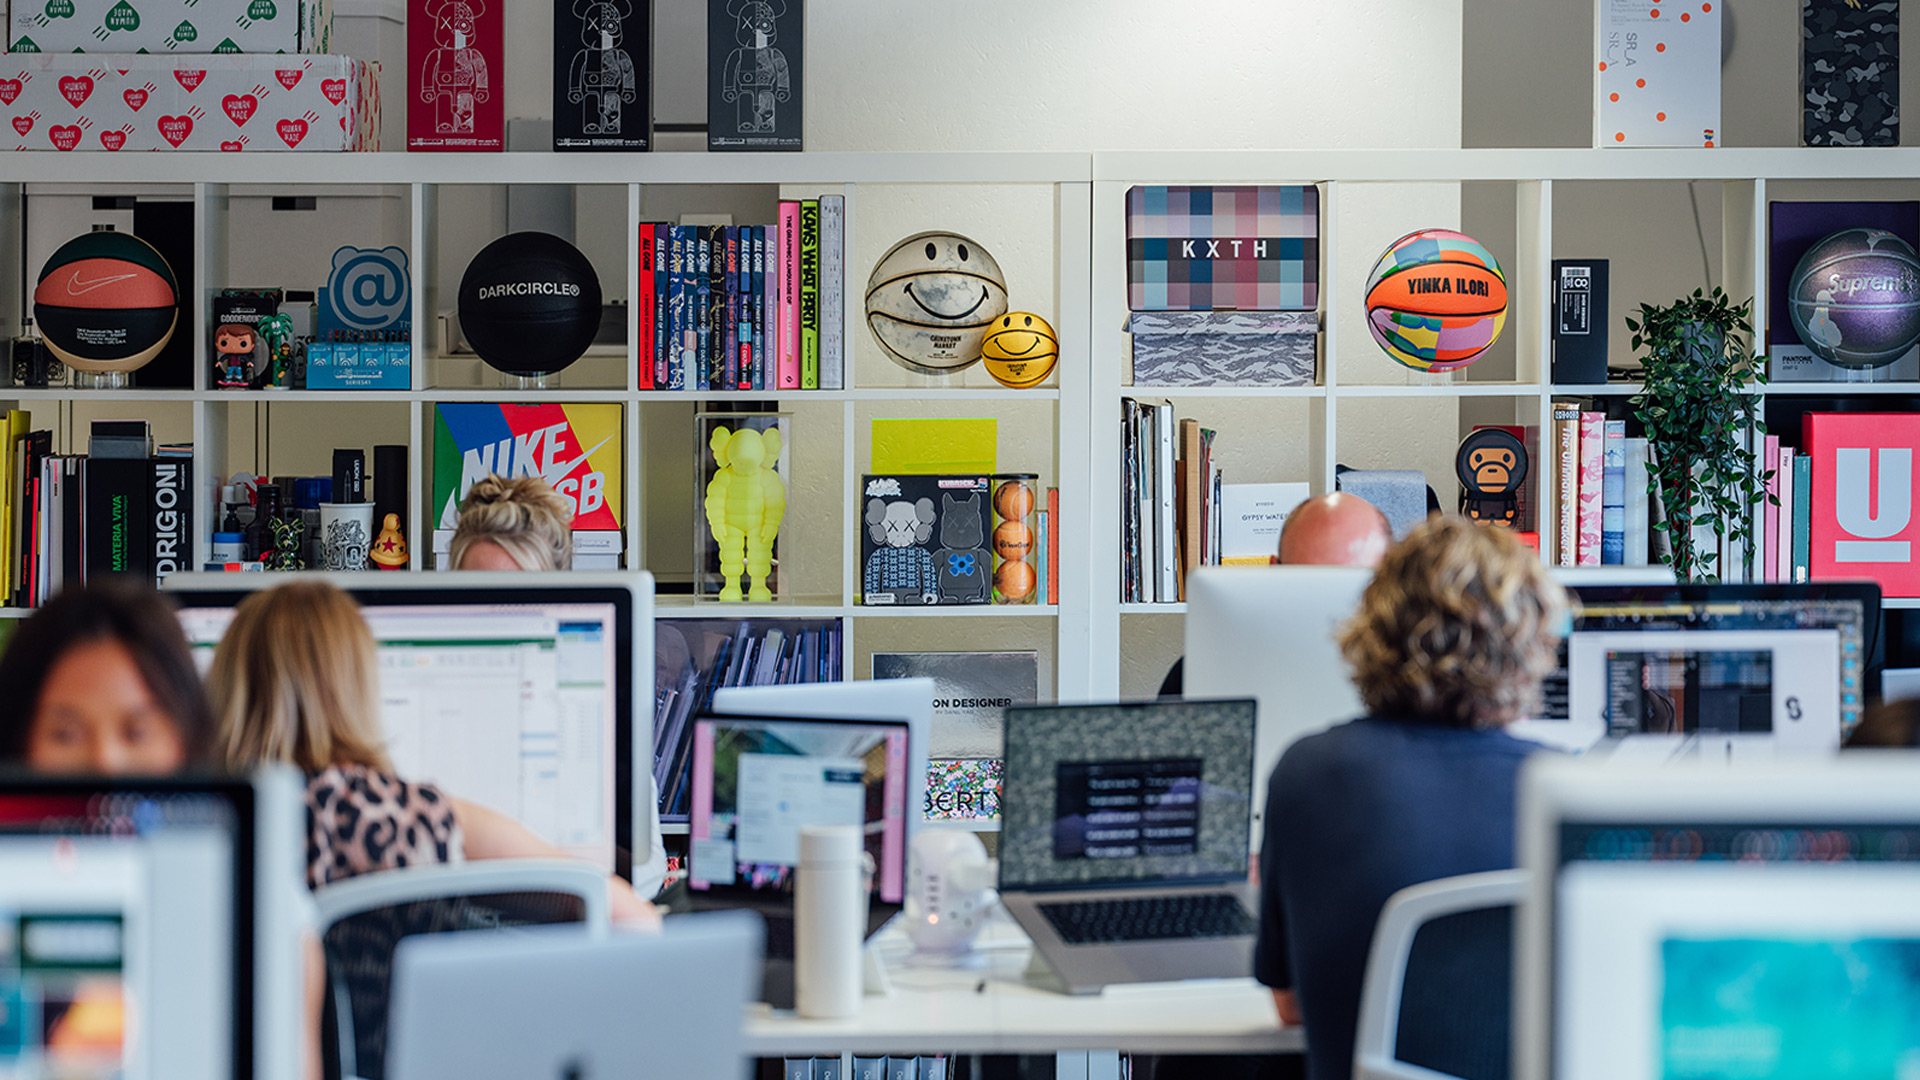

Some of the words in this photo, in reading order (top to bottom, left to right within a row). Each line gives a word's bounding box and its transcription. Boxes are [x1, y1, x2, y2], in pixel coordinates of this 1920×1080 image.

[802, 206, 816, 246] KAWS
[643, 238, 651, 251] ALL
[657, 238, 665, 251] ALL
[673, 240, 681, 253] ALL
[686, 239, 694, 252] ALL
[699, 239, 707, 252] ALL
[713, 241, 721, 253] ALL
[727, 239, 736, 252] ALL
[741, 240, 749, 252] ALL
[754, 239, 762, 252] ALL
[766, 240, 774, 252] ALL
[643, 251, 651, 272] GONE
[657, 251, 665, 272] GONE
[673, 253, 681, 273] GONE
[686, 253, 694, 273] GONE
[699, 252, 707, 273] GONE
[713, 254, 721, 275] GONE
[727, 252, 736, 273] GONE
[741, 253, 749, 273] GONE
[754, 252, 762, 273] GONE
[766, 253, 774, 273] GONE
[802, 248, 816, 290] WHAT
[1407, 277, 1452, 294] YINKA
[1456, 278, 1489, 297] ILORI
[1828, 273, 1904, 298] Suprem
[786, 296, 792, 305] OF
[802, 291, 816, 331] PARTY
[1561, 428, 1572, 448] The
[460, 421, 567, 502] NIKE
[1561, 451, 1572, 500] Ultimate
[556, 471, 605, 516] SB
[1561, 504, 1572, 551] Sneaker
[112, 523, 122, 571] MATERIA
[1560, 553, 1571, 568] Bo
[932, 699, 949, 708] ON
[952, 698, 1012, 708] DESIGNER
